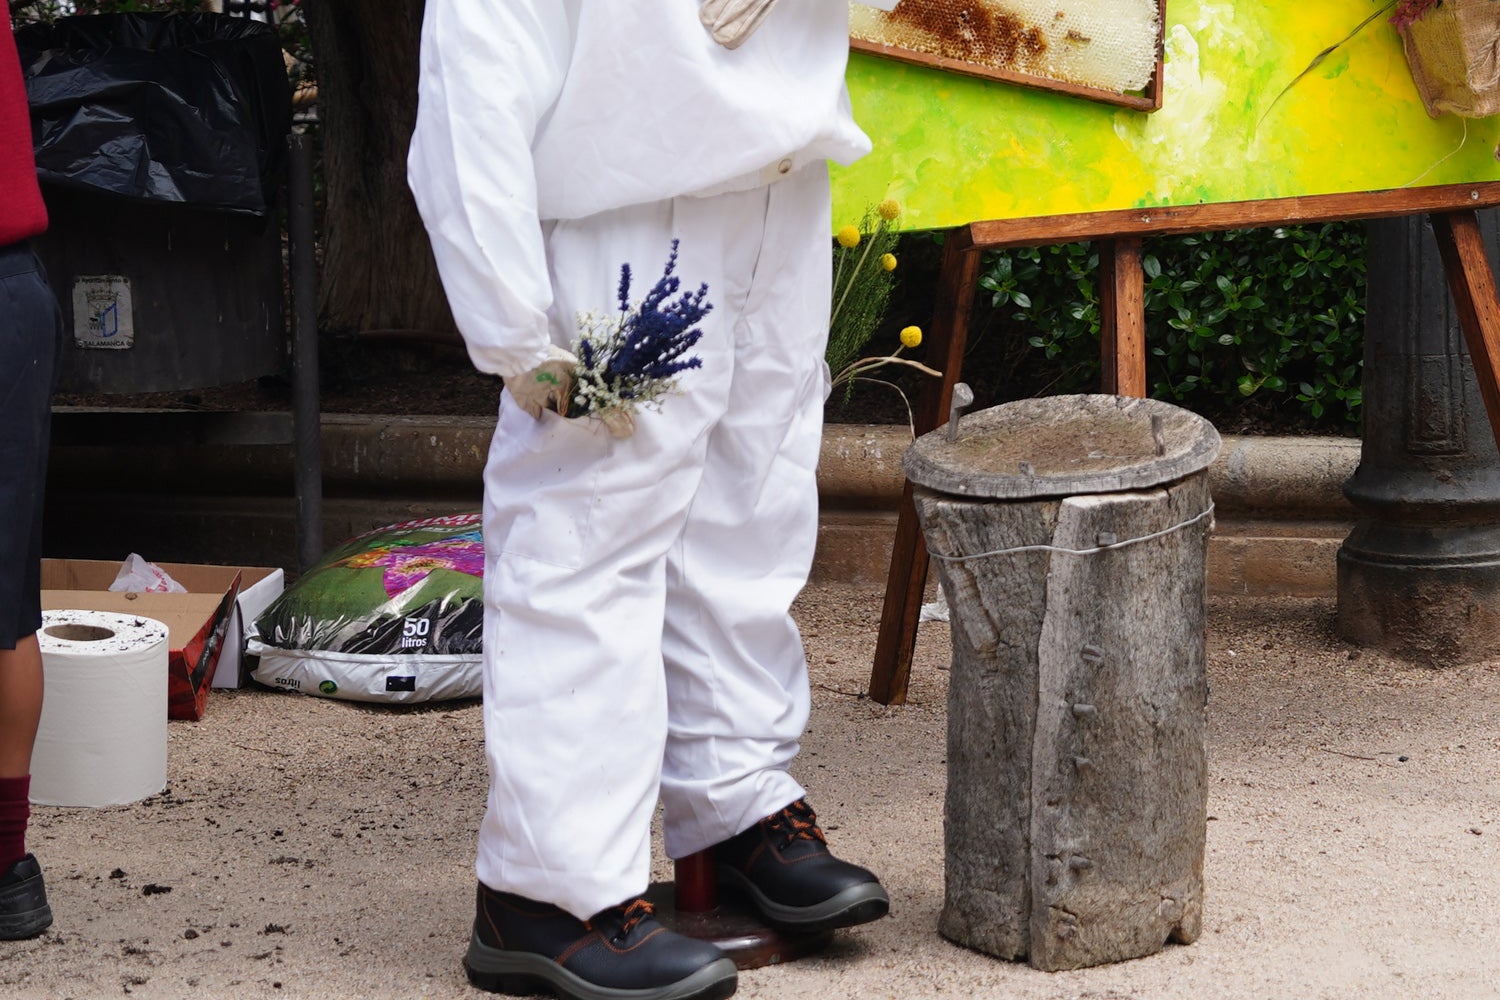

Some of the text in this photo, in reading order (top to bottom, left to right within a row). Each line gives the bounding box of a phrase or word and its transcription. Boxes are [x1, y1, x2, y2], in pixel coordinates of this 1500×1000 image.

[403, 617, 430, 637] 50
[401, 637, 428, 648] litros
[274, 676, 301, 689] litros
